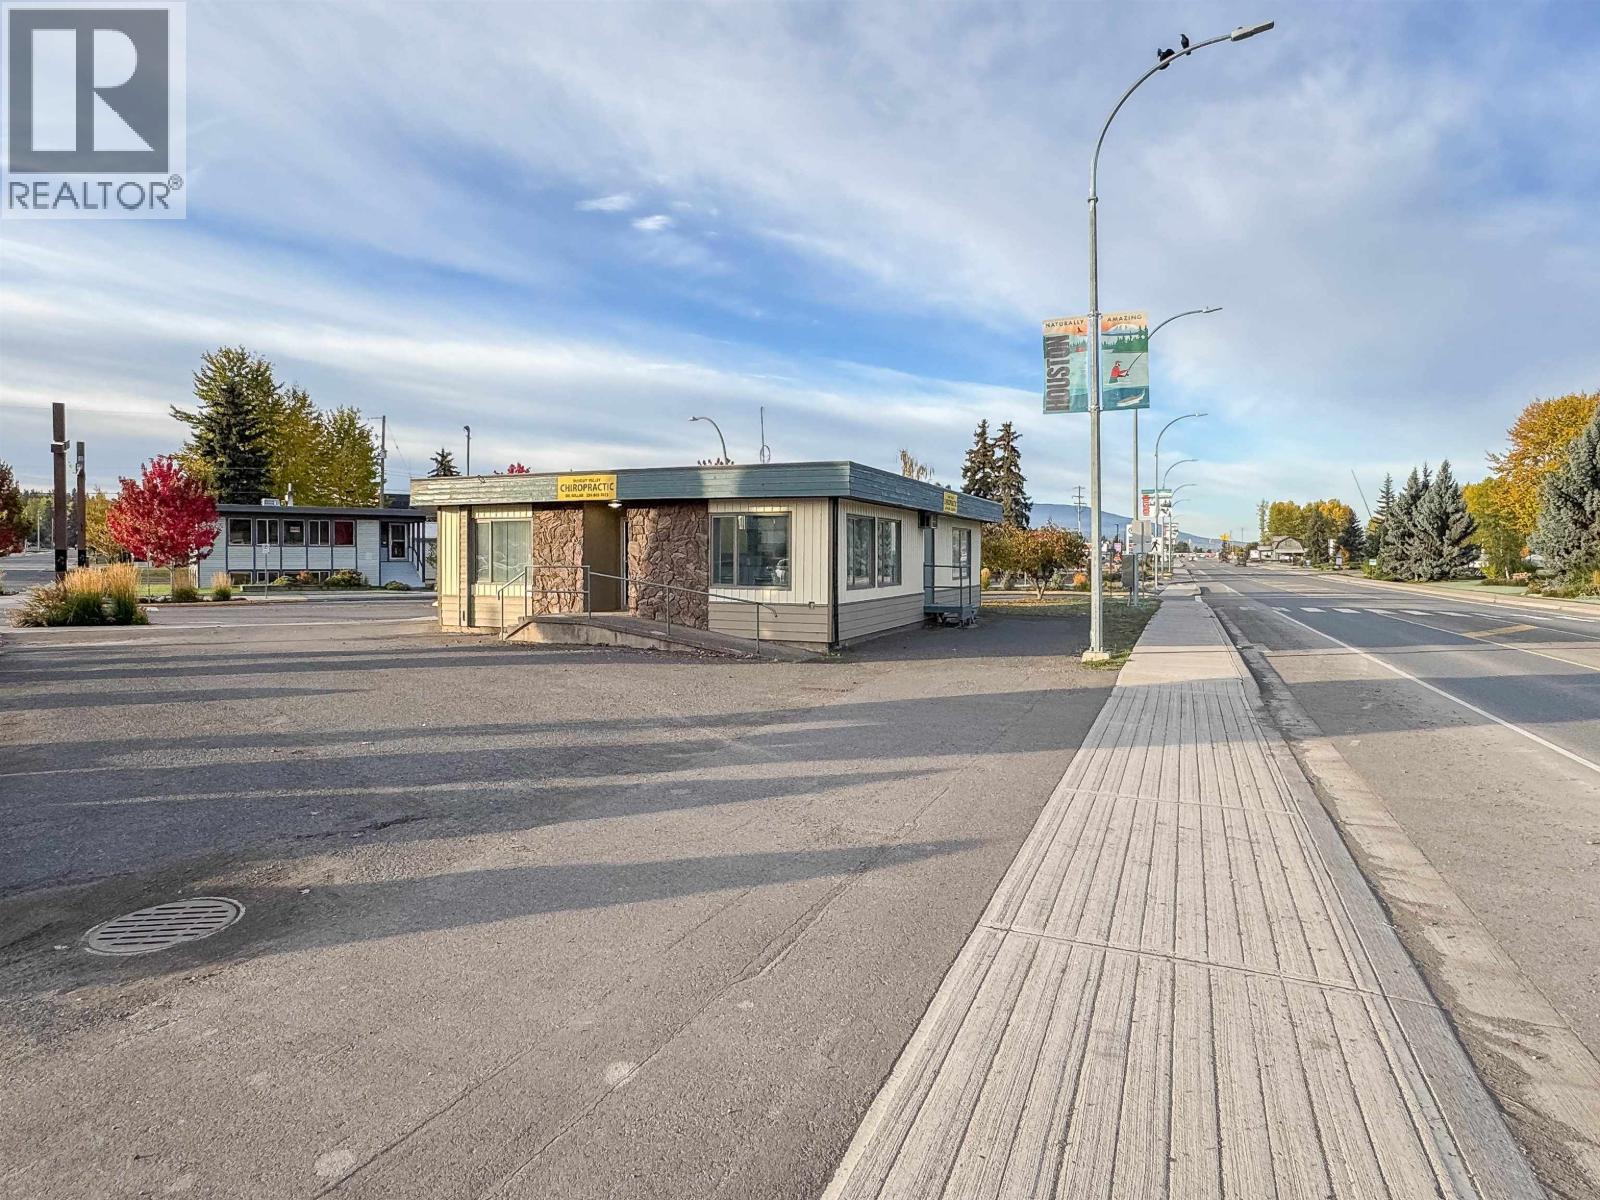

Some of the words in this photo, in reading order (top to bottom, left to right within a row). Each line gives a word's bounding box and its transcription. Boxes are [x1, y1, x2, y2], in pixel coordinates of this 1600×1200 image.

[1107, 314, 1142, 322] AMAZING
[1045, 319, 1084, 328] NATURALLY
[1046, 335, 1070, 411] HOUSTON
[560, 482, 614, 492] CHIROPRACTIC
